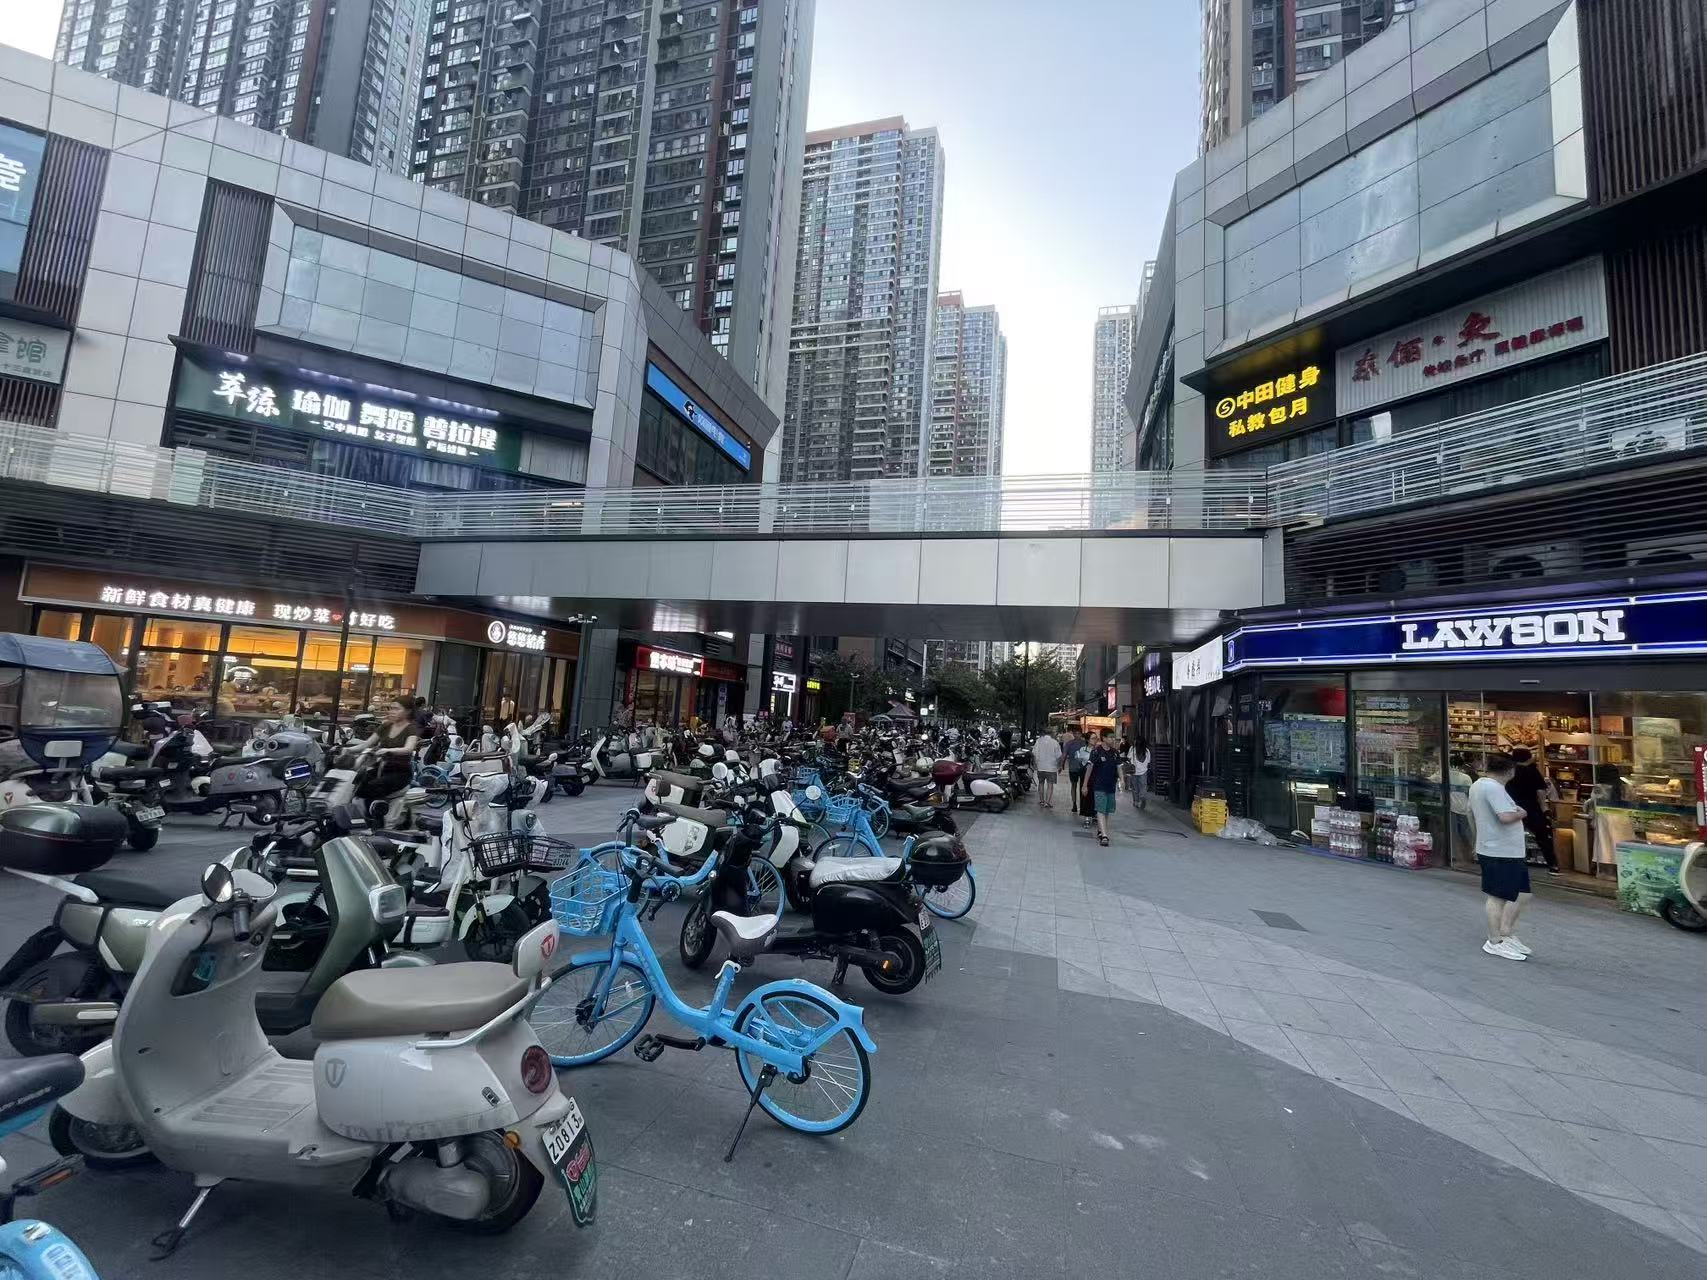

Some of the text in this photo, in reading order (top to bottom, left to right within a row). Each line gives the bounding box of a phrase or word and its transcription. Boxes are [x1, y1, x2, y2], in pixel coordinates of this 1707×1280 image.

[1237, 366, 1320, 409] 中田健身
[292, 389, 351, 421] 瑜伽
[358, 402, 416, 433] 舞蹈
[423, 415, 498, 450] 普拉提
[1229, 397, 1307, 437] 私教包月
[102, 586, 256, 615] 新鲜食材真健康
[1402, 610, 1625, 649] LAWSON
[549, 1114, 580, 1160] Z0813
